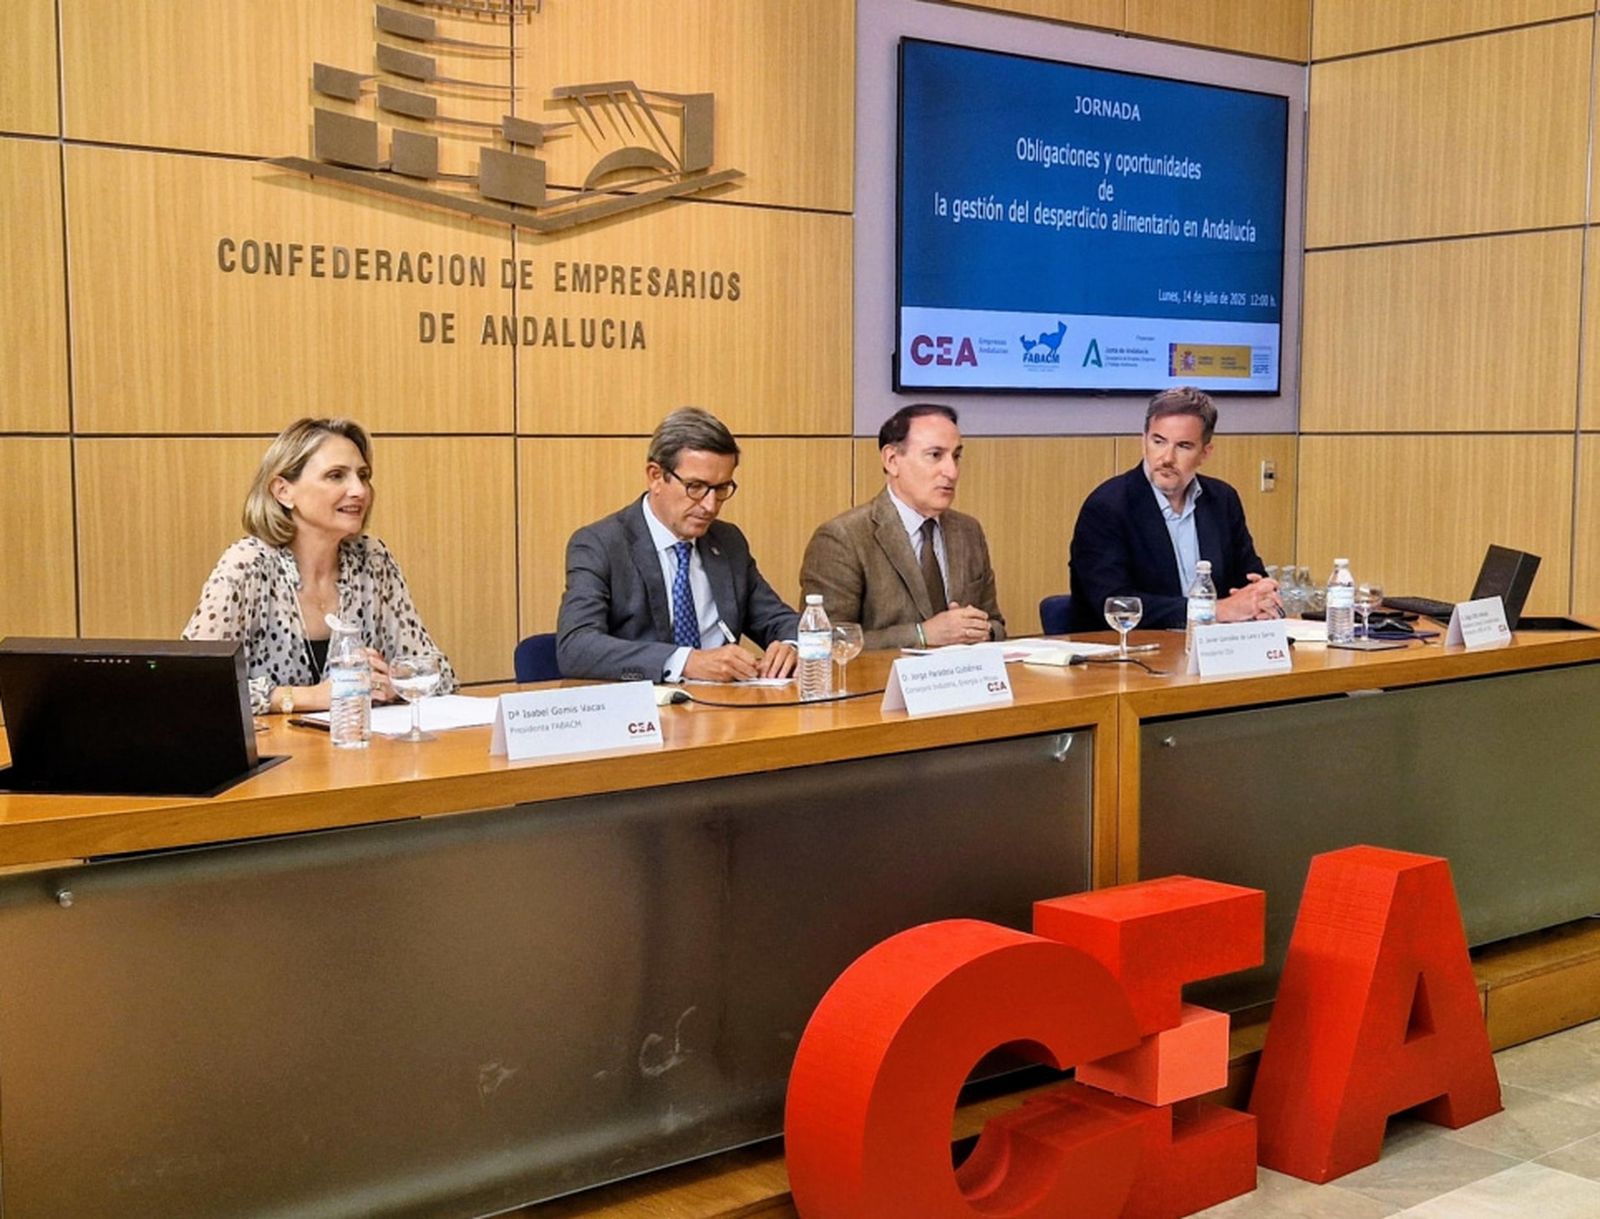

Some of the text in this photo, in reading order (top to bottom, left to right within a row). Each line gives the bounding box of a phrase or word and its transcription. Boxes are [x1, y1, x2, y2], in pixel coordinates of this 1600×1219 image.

[1074, 96, 1141, 122] JORNADA
[1016, 137, 1202, 181] Obligaciones y oportunidades
[1098, 179, 1114, 201] de
[934, 192, 1257, 243] la gestión del desperdicio alimentario en Andalucía
[217, 237, 742, 302] CONFEDERACION DE EMPRESARIOS
[1183, 289, 1192, 303] 14
[1193, 290, 1202, 304] de
[1203, 291, 1218, 306] julio
[1220, 292, 1229, 305] de
[1230, 292, 1247, 306] 2025
[419, 311, 647, 350] DE ANDALUCIA
[910, 334, 979, 367] CEA
[1022, 352, 1060, 364] FABACM
[508, 702, 606, 721] Dª Isabel Gomis Vacas
[627, 721, 656, 734] CEA
[784, 845, 1505, 1219] CEA
